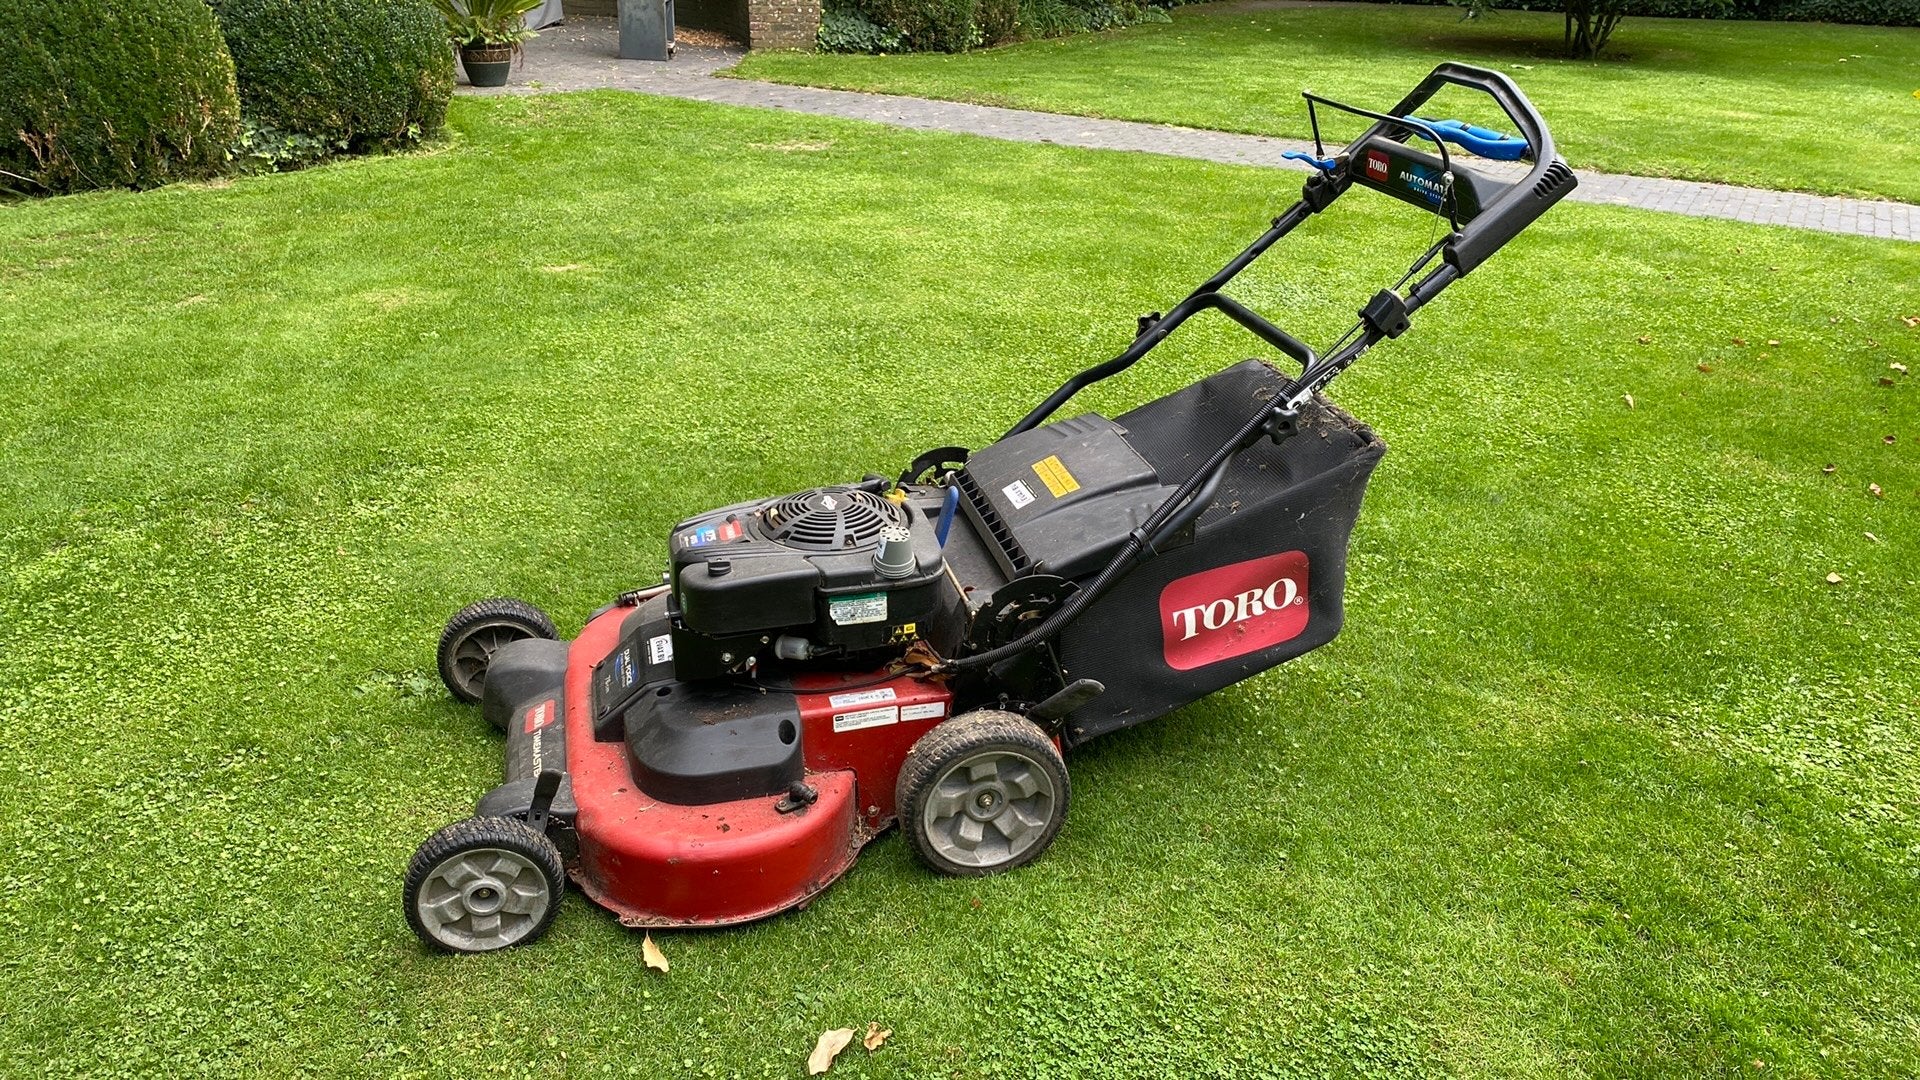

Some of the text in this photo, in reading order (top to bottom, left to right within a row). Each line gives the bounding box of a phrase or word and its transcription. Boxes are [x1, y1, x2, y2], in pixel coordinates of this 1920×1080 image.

[1368, 157, 1388, 173] TORO
[1399, 170, 1445, 194] AUTOMAT
[532, 728, 543, 778] TIMEMASTE
